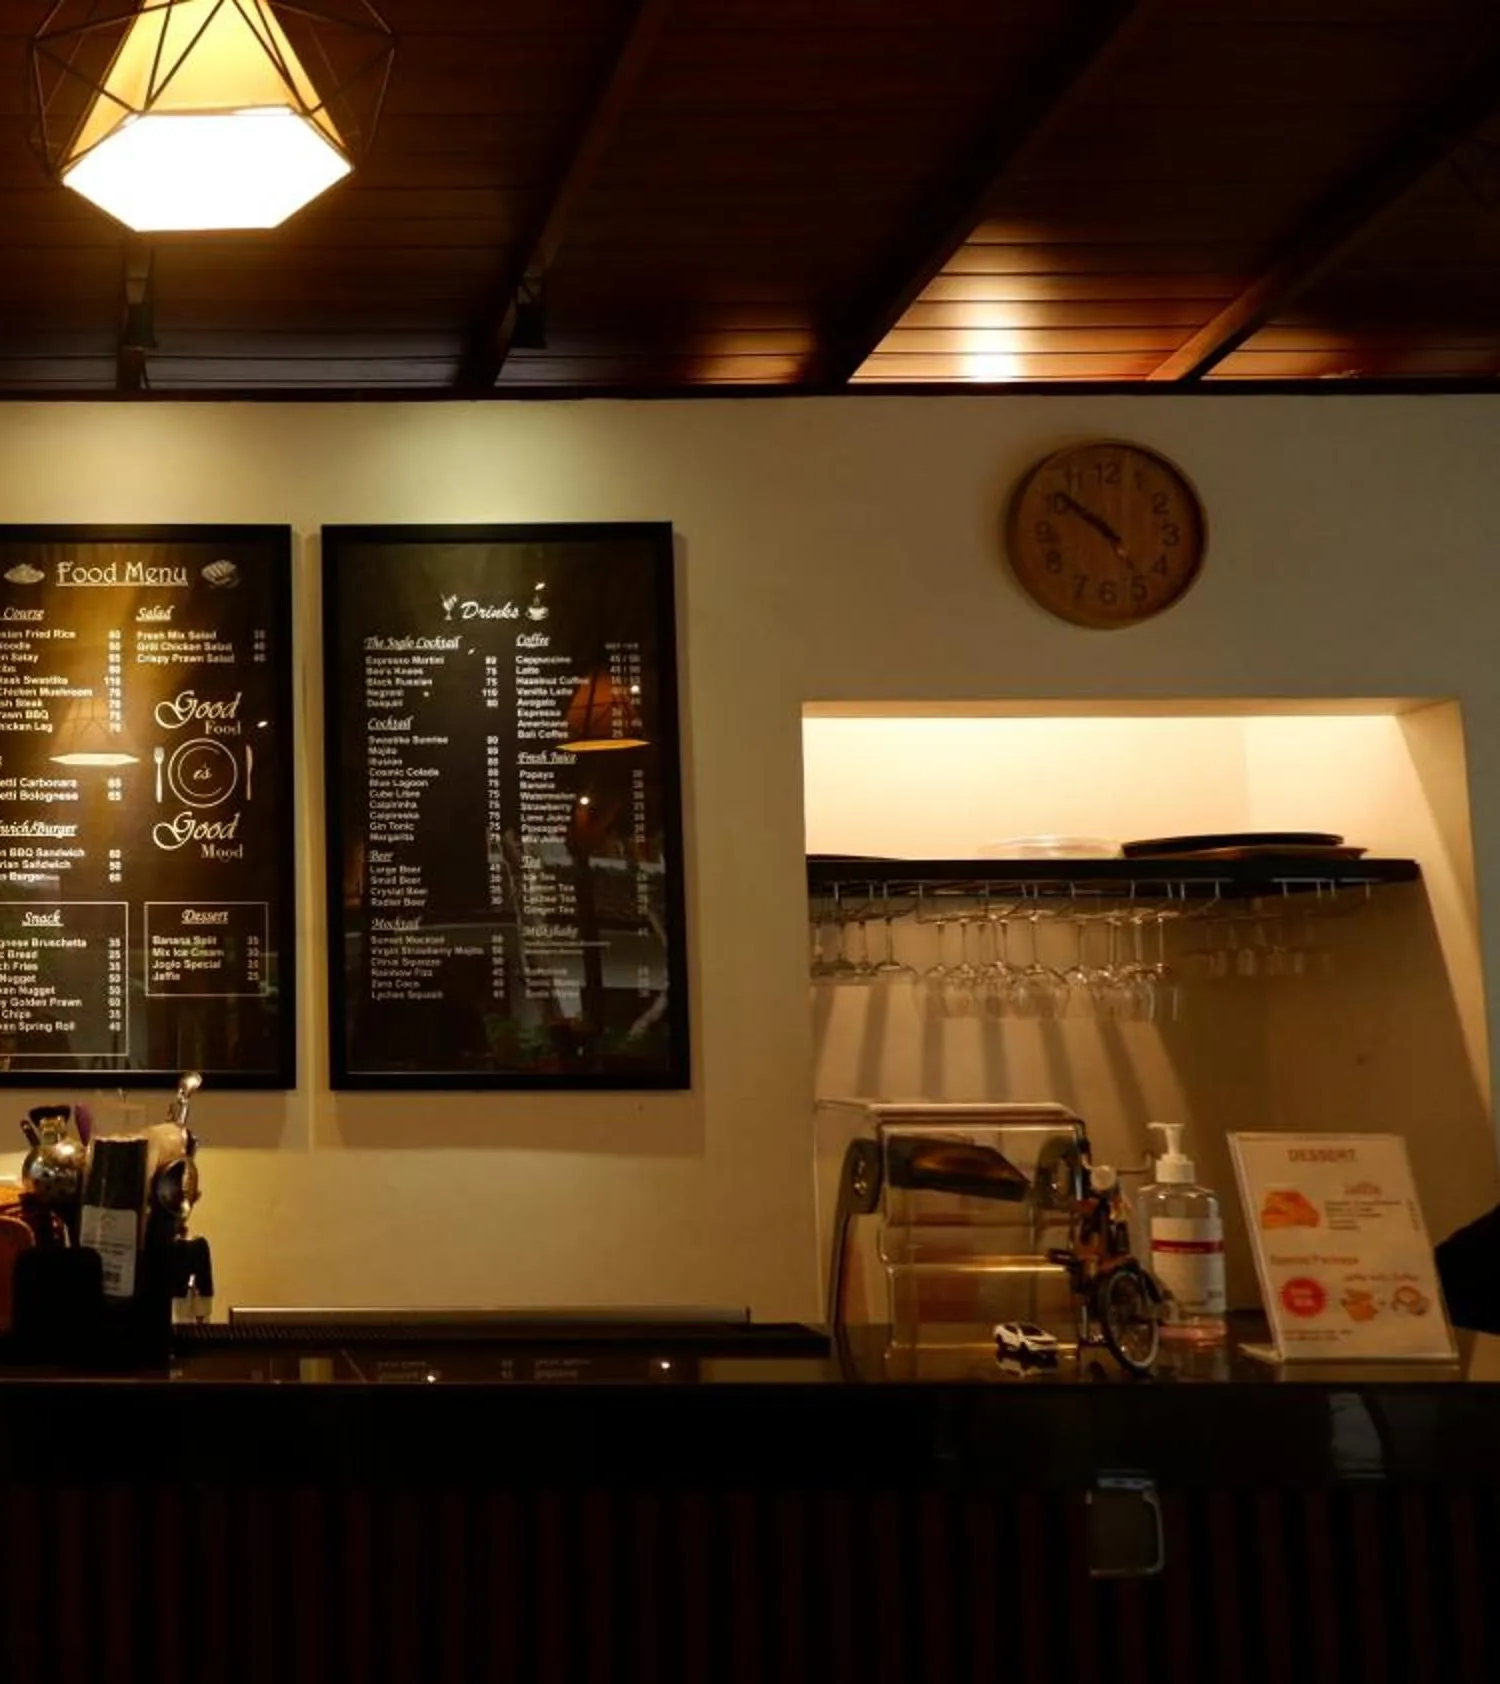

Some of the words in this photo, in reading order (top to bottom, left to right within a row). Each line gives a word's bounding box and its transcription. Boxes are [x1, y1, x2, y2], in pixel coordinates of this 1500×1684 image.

[1064, 466, 1083, 490] 11
[1095, 462, 1121, 484] 12
[1152, 493, 1169, 514] 2
[1035, 520, 1053, 544] 9
[1161, 523, 1180, 547] 3
[1045, 551, 1062, 574] 8
[1152, 555, 1168, 575] 4
[56, 561, 117, 586] Food
[125, 561, 188, 586] Menu
[1073, 574, 1088, 598] 7
[1130, 575, 1147, 599] 5
[1099, 581, 1116, 605] 6
[4, 607, 44, 620] Course
[136, 605, 175, 621] Salad
[460, 601, 520, 620] Drinks
[25, 630, 50, 639] Fried
[53, 630, 76, 639] Rice
[168, 630, 185, 639] Mix
[188, 630, 216, 639] Salad
[515, 632, 550, 647] Coffee
[137, 642, 158, 651] Grill
[160, 642, 201, 651] Chicken
[204, 642, 232, 651] Salad
[11, 653, 39, 663] Satay
[137, 654, 170, 665] Crispy
[172, 654, 204, 663] Prawn
[207, 654, 235, 663] Salad
[515, 665, 540, 674] Latte
[39, 688, 92, 697] Mushroom
[515, 687, 548, 695] Vanilla
[25, 710, 49, 719] BBQ
[155, 689, 242, 729] Good
[205, 721, 241, 734] Food
[367, 715, 414, 730] Cocktail
[517, 730, 536, 739] Bali
[538, 730, 568, 739] Coffee
[369, 768, 405, 776] Cosmic
[519, 770, 555, 780] Papaya
[20, 777, 77, 788] Carbonara
[392, 779, 429, 789] Lagoon
[20, 790, 79, 802] Bolognese
[488, 789, 500, 798] 75
[153, 811, 240, 850] Good
[369, 822, 386, 831] Gin
[389, 822, 414, 831] Tonic
[9, 848, 33, 857] BBQ
[35, 848, 85, 857] Sandwich
[202, 843, 243, 862] Mood
[22, 860, 72, 869] Sandwich
[9, 872, 44, 882] Burger
[21, 909, 63, 926] Snack
[181, 909, 228, 924] Dessert
[30, 938, 87, 947] Bruschetta
[152, 936, 191, 945] Banana
[193, 936, 217, 947] Split
[7, 950, 37, 959] Bread
[152, 948, 170, 957] Mix
[172, 948, 190, 957] Ice
[192, 948, 224, 957] Cream
[12, 961, 39, 971] Fries
[152, 960, 181, 970] Joglo
[183, 960, 221, 971] Special
[18, 985, 55, 997] Nugget
[10, 998, 47, 1007] Golden
[49, 998, 83, 1007] Prawn
[1, 1009, 31, 1021] Chips
[18, 1021, 52, 1034] Spring
[55, 1021, 76, 1031] Roll
